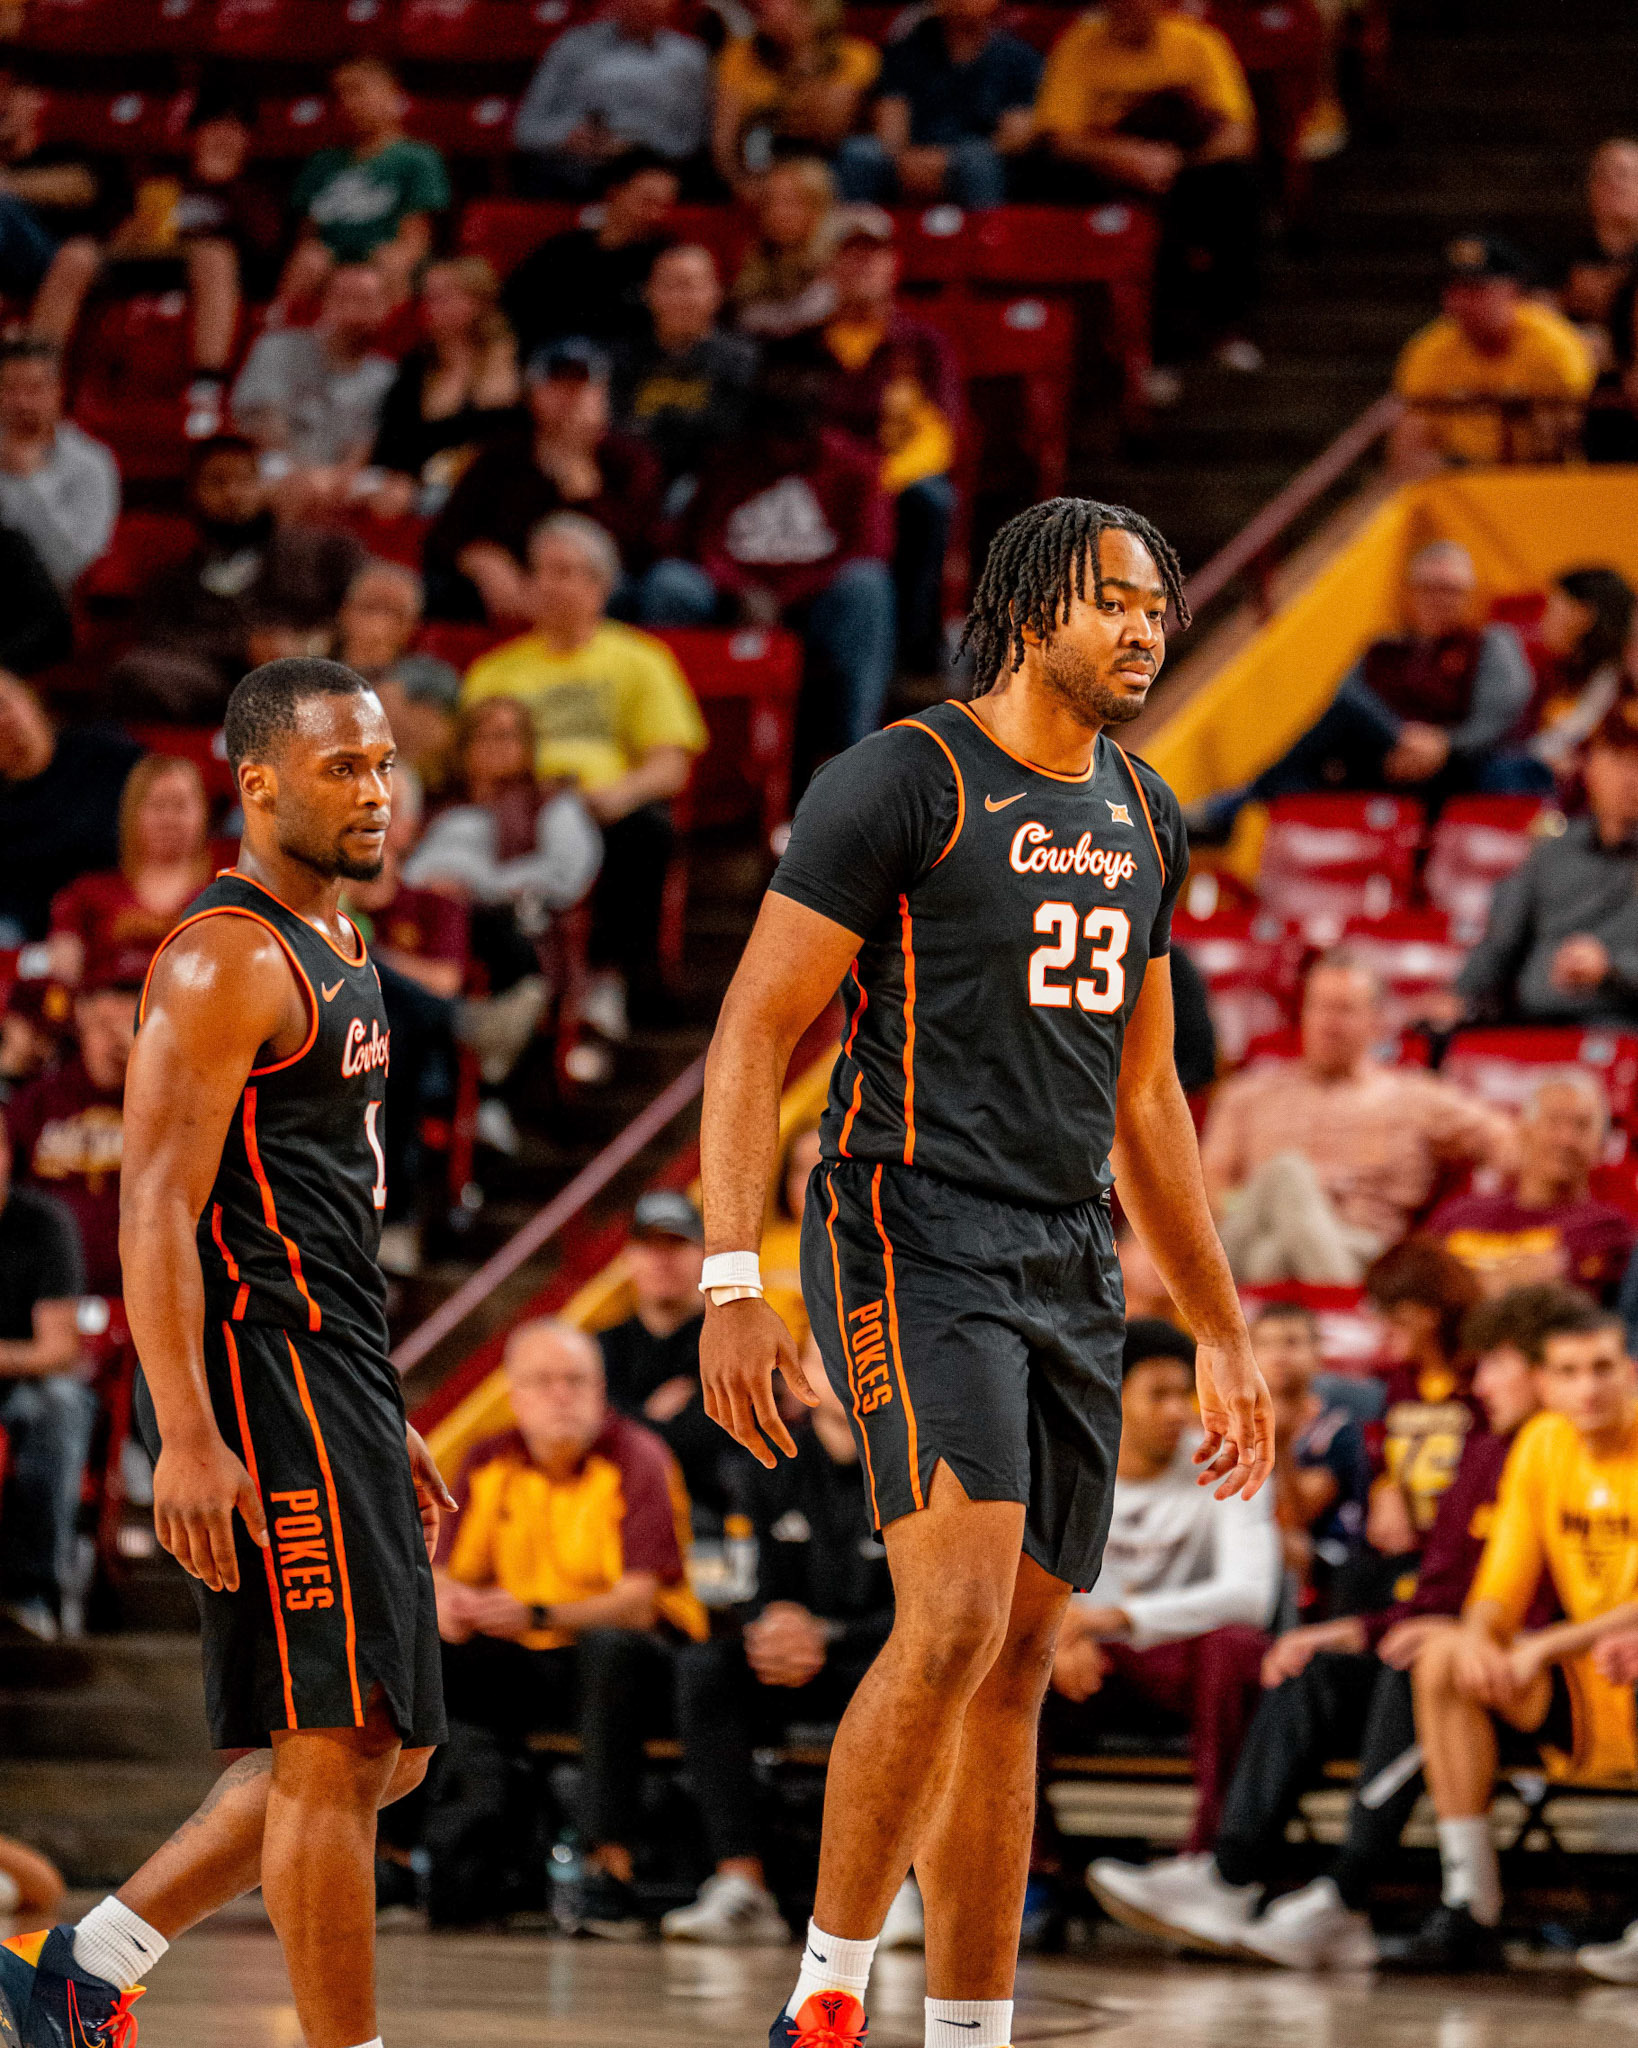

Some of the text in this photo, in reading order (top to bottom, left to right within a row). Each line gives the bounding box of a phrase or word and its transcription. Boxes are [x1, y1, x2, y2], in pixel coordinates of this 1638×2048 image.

[1009, 820, 1138, 890] Cowboys
[1028, 900, 1131, 1015] 23
[364, 1101, 387, 1209] 1
[848, 1299, 893, 1415] POKES
[270, 1488, 334, 1612] POKES
